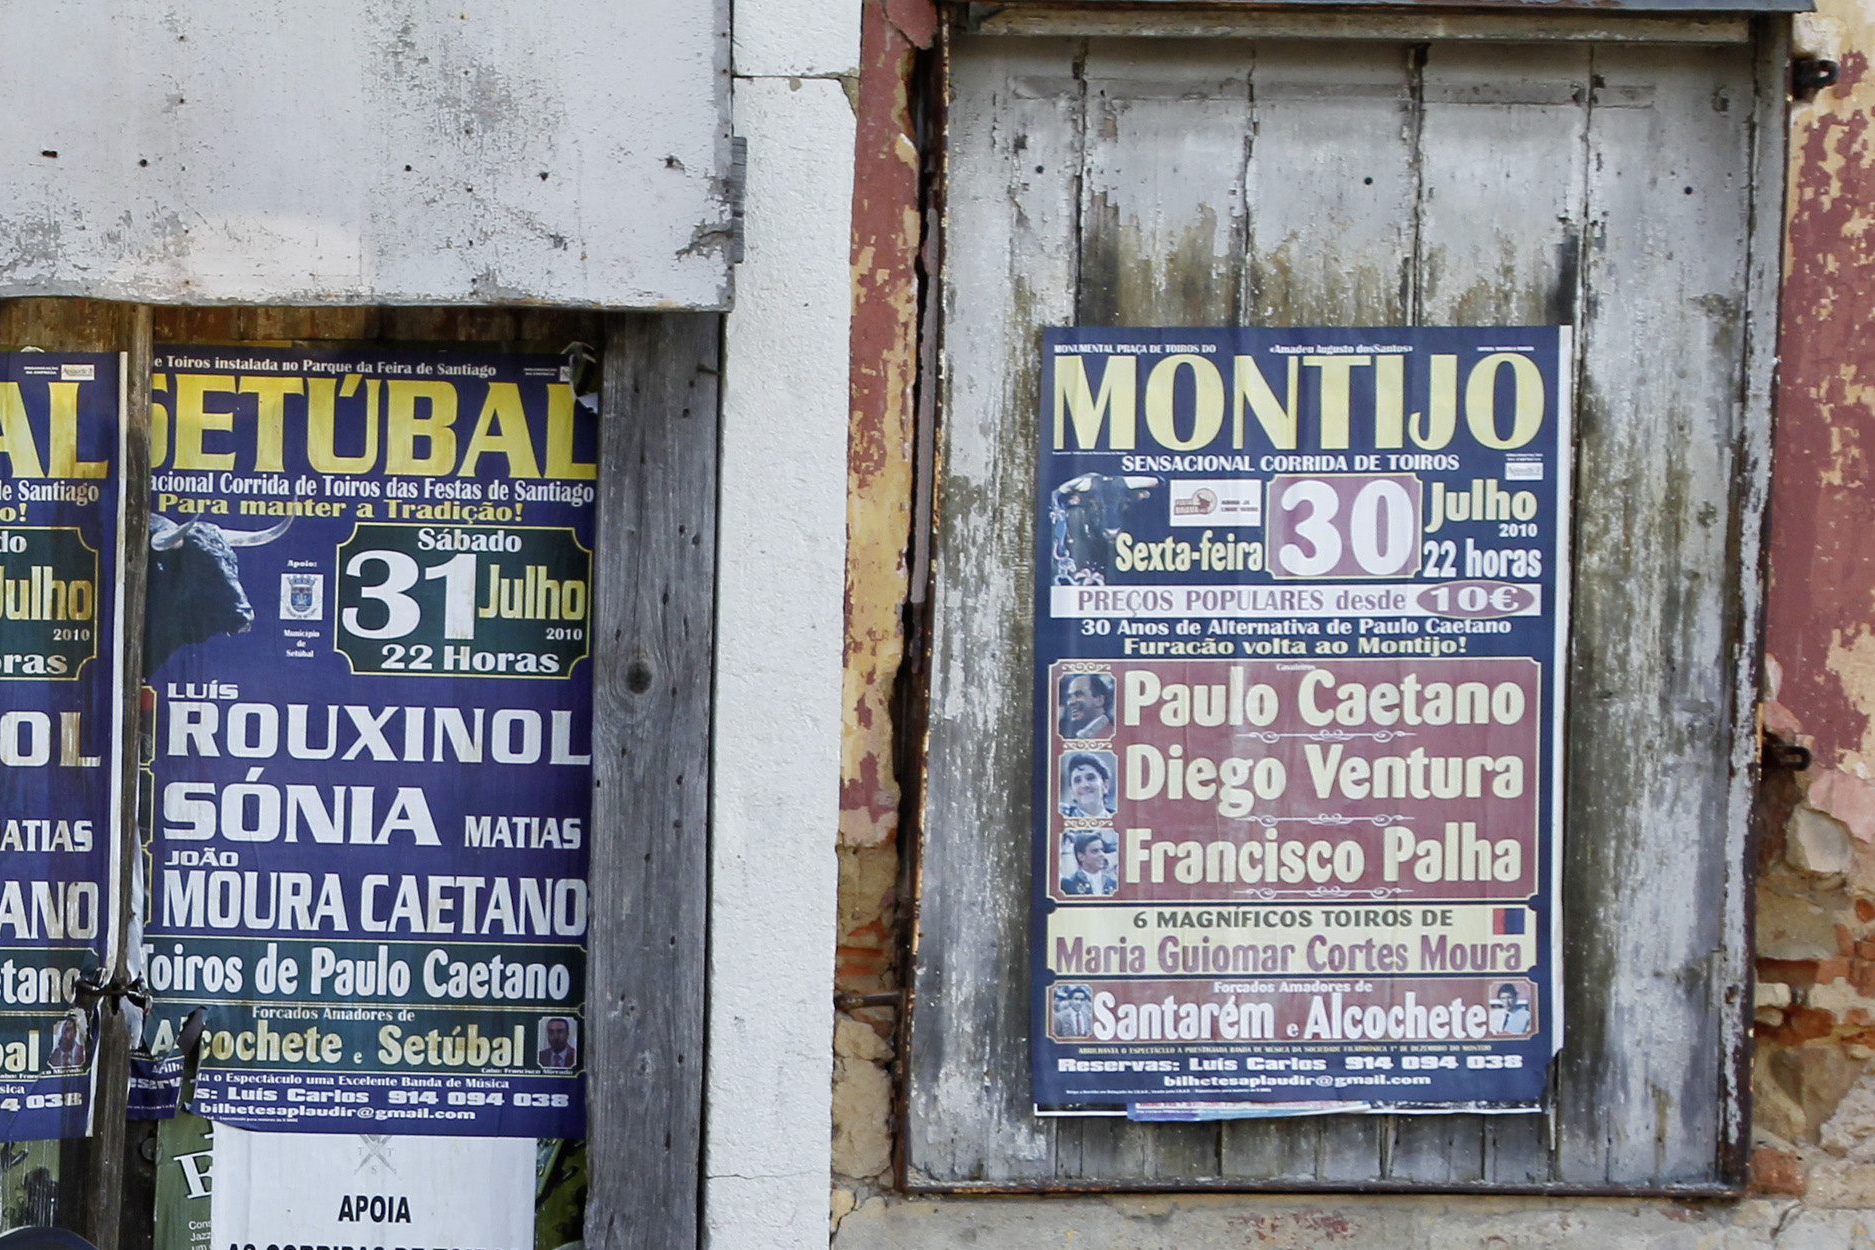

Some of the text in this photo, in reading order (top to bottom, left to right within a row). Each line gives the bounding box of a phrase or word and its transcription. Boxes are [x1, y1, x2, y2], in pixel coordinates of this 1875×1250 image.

[1053, 352, 1545, 451] MONTIJO
[151, 373, 597, 480] ETÚBAL
[1122, 454, 1460, 472] SENSACIONAL CORRIDA DE TOIROS
[1425, 478, 1538, 533] Julho
[417, 528, 522, 552] Sábado
[1279, 479, 1414, 576] 30
[1499, 523, 1538, 537] 2010
[1115, 530, 1263, 572] Sexta-feira
[1423, 538, 1542, 578] 22 horas
[342, 550, 477, 640] 31
[478, 564, 586, 620] Julho
[1079, 586, 1520, 618] PREÇOS POPULARES desde 10€
[53, 629, 90, 641] 2010
[546, 628, 583, 640] 2010
[1081, 618, 1512, 635] 30 Anos de Alternativa de Paulo Caetano
[381, 644, 560, 673] 22 Horas
[1124, 637, 1467, 658] Furacão volta ao Montijo!
[167, 680, 239, 700] LUÍS
[1124, 666, 1525, 727] Paulo Caetano
[167, 701, 591, 765] ROUXINOL
[1125, 744, 1524, 817] Diego Ventura
[163, 767, 581, 849] SÓNIA MATIAS
[164, 847, 239, 867] JOÃO
[1125, 821, 1522, 884] Francisco Palha
[163, 869, 588, 936] MOURA CAETANO
[1133, 906, 1453, 928] 6 MAGNÍFICOS TOIROS DE
[255, 943, 299, 995] de
[310, 945, 411, 997] Paulo
[423, 949, 570, 1001] Caetano
[1056, 934, 1521, 973] Maria Guiomar Cortes Moura
[1093, 991, 1487, 1041] Santarém e Alcochete
[151, 1017, 525, 1067] Acochete e Setúbal
[1058, 1055, 1523, 1072] Reservas: Luís Carlos 914 094 038
[1164, 1075, 1431, 1088] bilhetesaplaudir@gmail.com
[338, 1195, 411, 1224] APOIA
